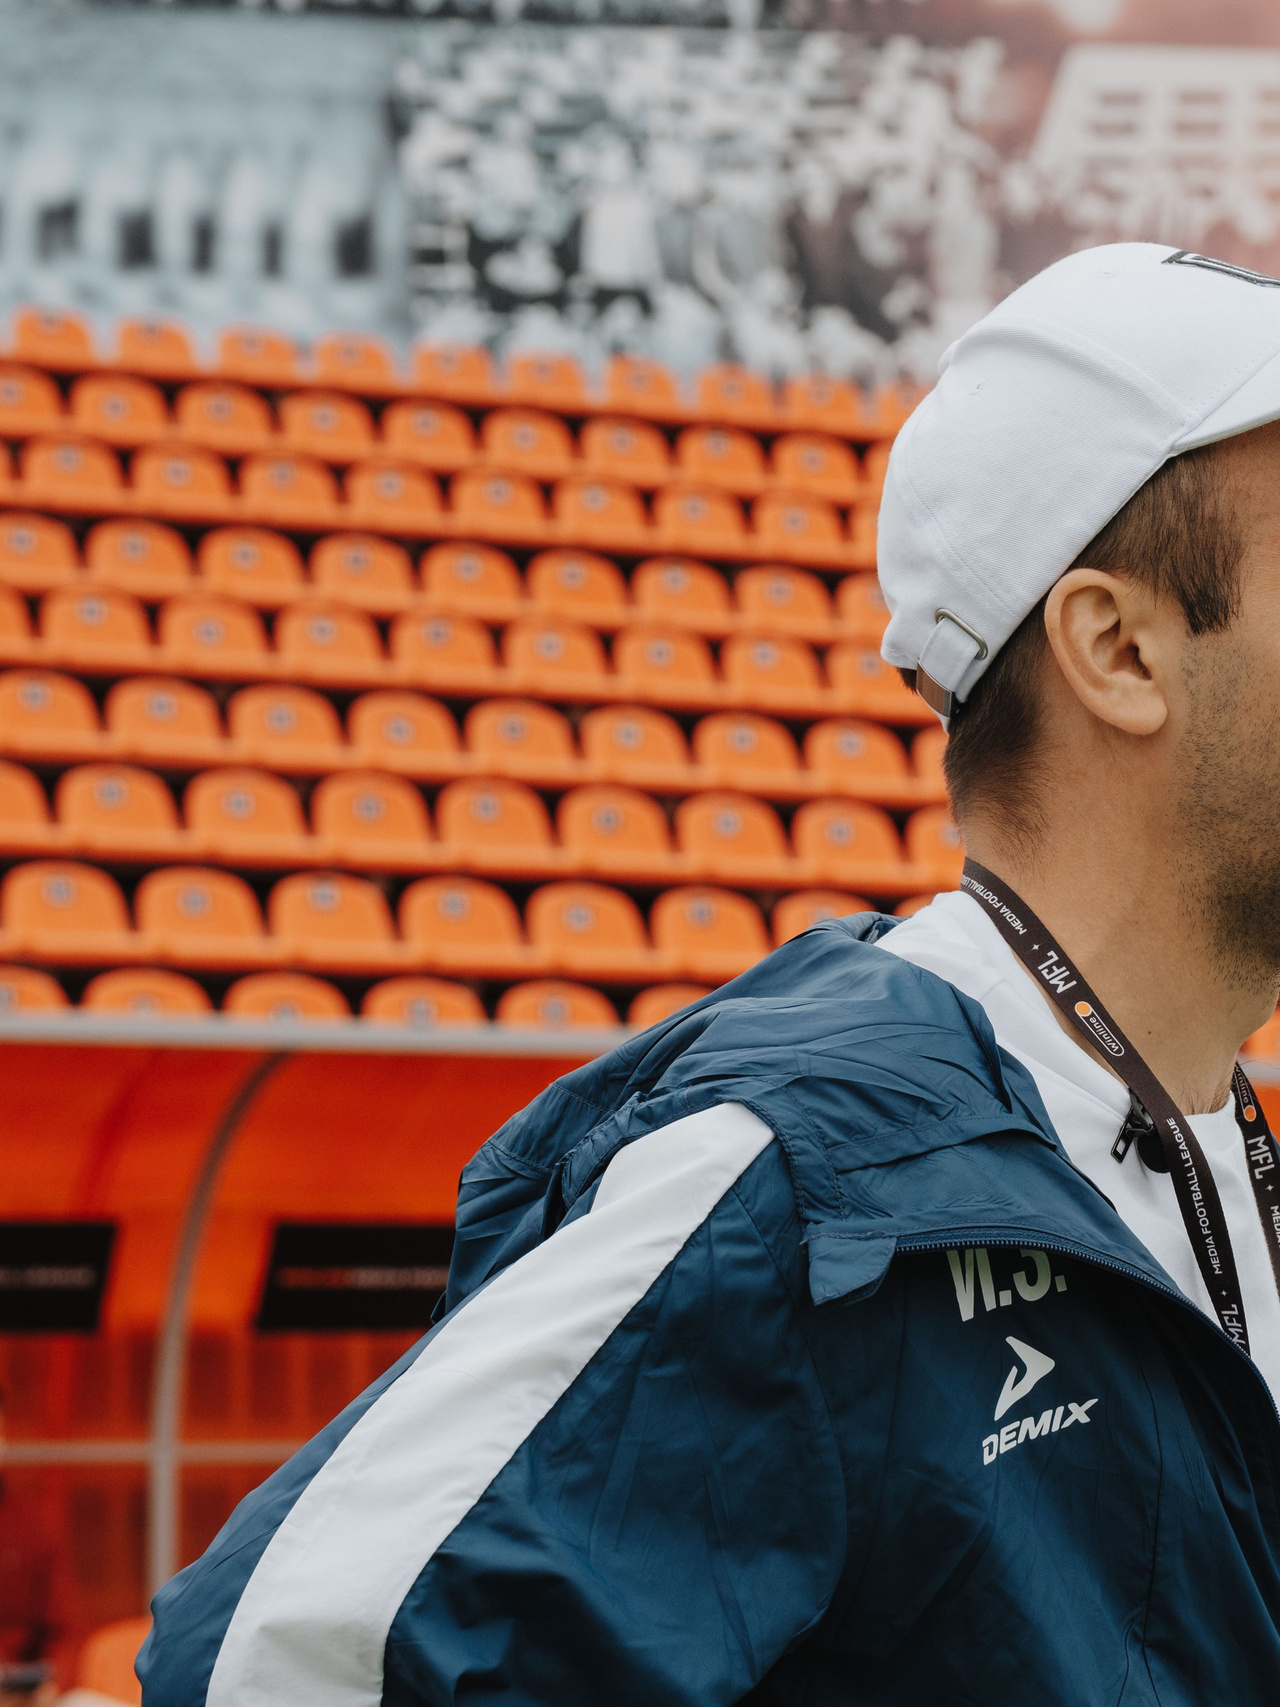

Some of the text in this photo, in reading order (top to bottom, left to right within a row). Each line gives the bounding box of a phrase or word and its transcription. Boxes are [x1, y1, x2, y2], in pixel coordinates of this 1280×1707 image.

[968, 879, 1003, 909] FOOTBALL
[999, 904, 1028, 935] MEDIA
[1037, 950, 1077, 994] MFL
[1247, 1134, 1275, 1180] MFL
[1166, 1117, 1223, 1275] MEDIA FOOTBALL LEAGUE
[982, 1398, 1099, 1466] DEMIX
